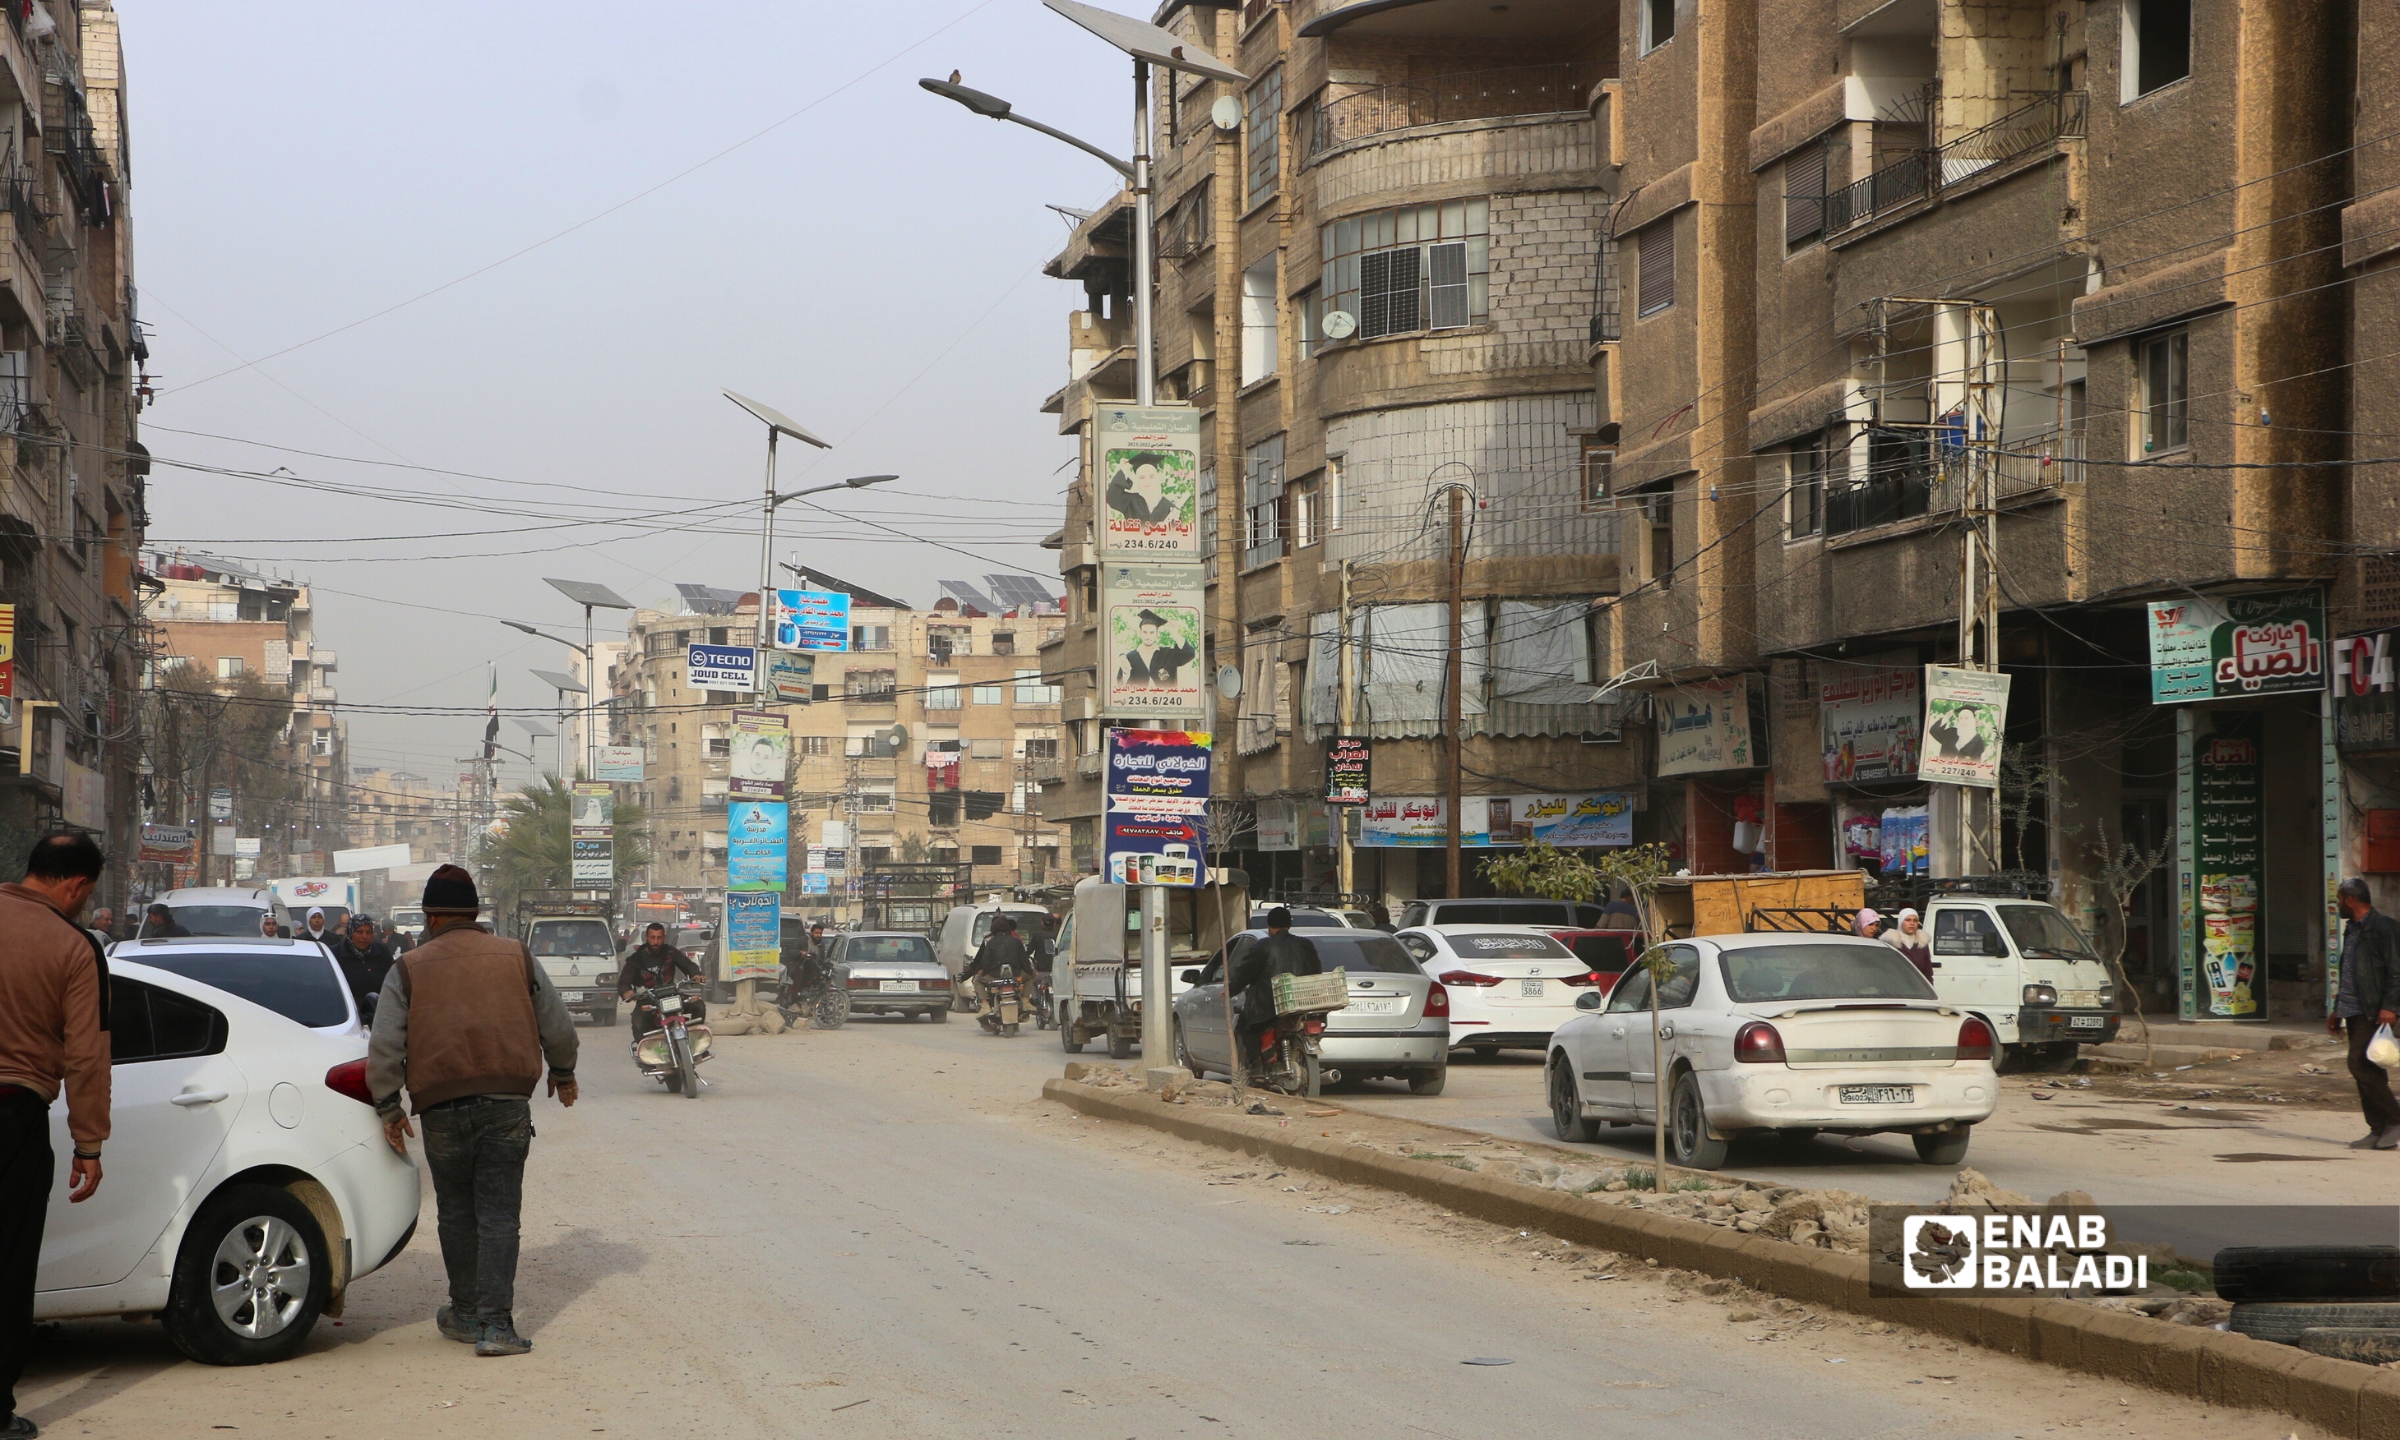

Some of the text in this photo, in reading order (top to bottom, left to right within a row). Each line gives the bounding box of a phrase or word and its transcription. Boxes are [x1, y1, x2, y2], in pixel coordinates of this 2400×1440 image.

[1141, 412, 1182, 421] مؤسسة
[1132, 422, 1192, 432] البيان التعليمية
[1124, 540, 1178, 549] 234.6/240
[1146, 570, 1188, 578] مؤسسة
[1136, 580, 1197, 590] البيان التعليمية
[798, 594, 811, 605] غاز
[2248, 626, 2294, 646] ماركت
[708, 654, 751, 666] TECNO
[2218, 624, 2318, 688] الضياء
[2334, 634, 2394, 697] FC4
[691, 670, 748, 680] JOUD CELL
[2167, 671, 2200, 684] موالح
[1112, 686, 1130, 694] الدين
[1131, 686, 1147, 694] جمال
[1149, 686, 1164, 694] سعيد
[1889, 667, 1916, 702] مركز
[2159, 682, 2210, 696] تحويل رصيد
[1128, 696, 1182, 706] 234.6/240
[2349, 712, 2395, 742] GAME
[1337, 740, 1362, 749] مركز
[2202, 740, 2256, 770] الضياء
[1114, 754, 1206, 773] الخولاني للتجارة
[1334, 762, 1363, 772] للدخان
[1941, 766, 1976, 777] 227/240
[1150, 776, 1163, 785] أنواع
[1164, 777, 1177, 786] جميع
[2202, 792, 2256, 808] معلبات
[1525, 798, 1567, 818] لليزر
[732, 837, 784, 846] البشائر العربية
[2202, 832, 2256, 846] موالح
[2202, 849, 2256, 865] تحويل رصيد
[296, 882, 328, 896] BRVO
[1524, 986, 1542, 995] 3866
